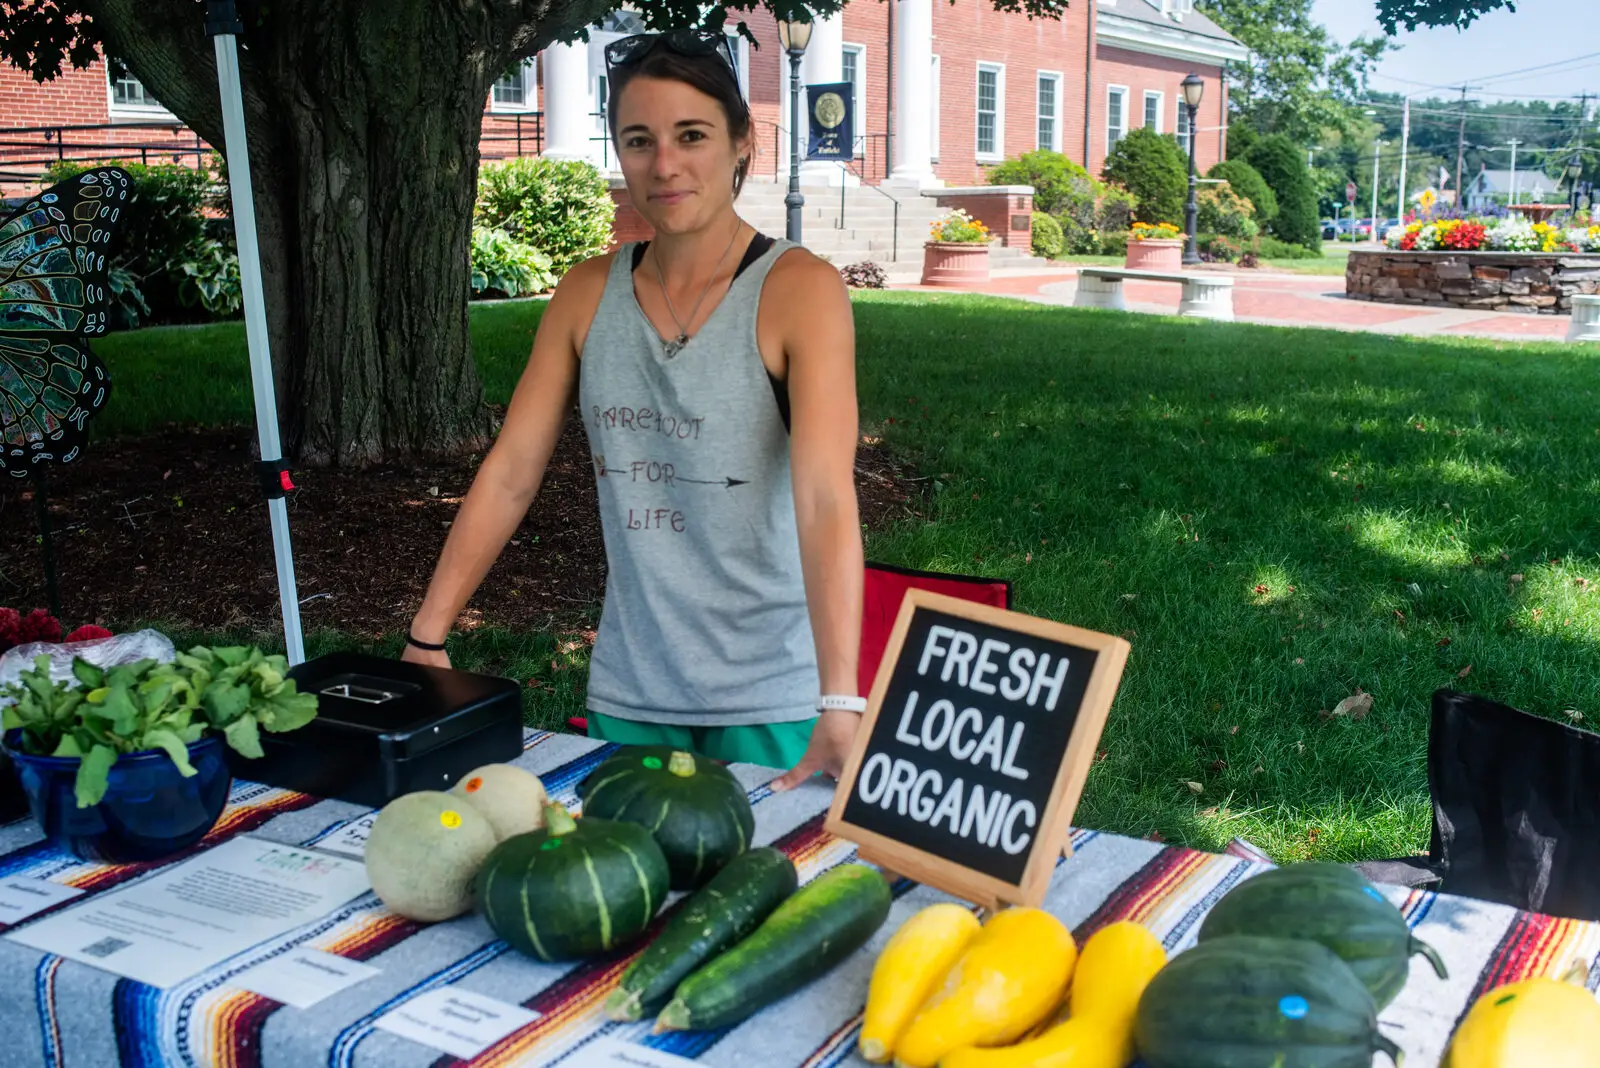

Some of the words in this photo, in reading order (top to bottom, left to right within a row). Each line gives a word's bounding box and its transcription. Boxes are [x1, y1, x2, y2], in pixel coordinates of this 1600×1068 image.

[630, 461, 676, 488] FOR
[627, 508, 686, 532] LIFE
[917, 625, 1070, 712] FRESH
[895, 690, 1029, 781] LOCAL
[858, 752, 1037, 855] ORGANIC
